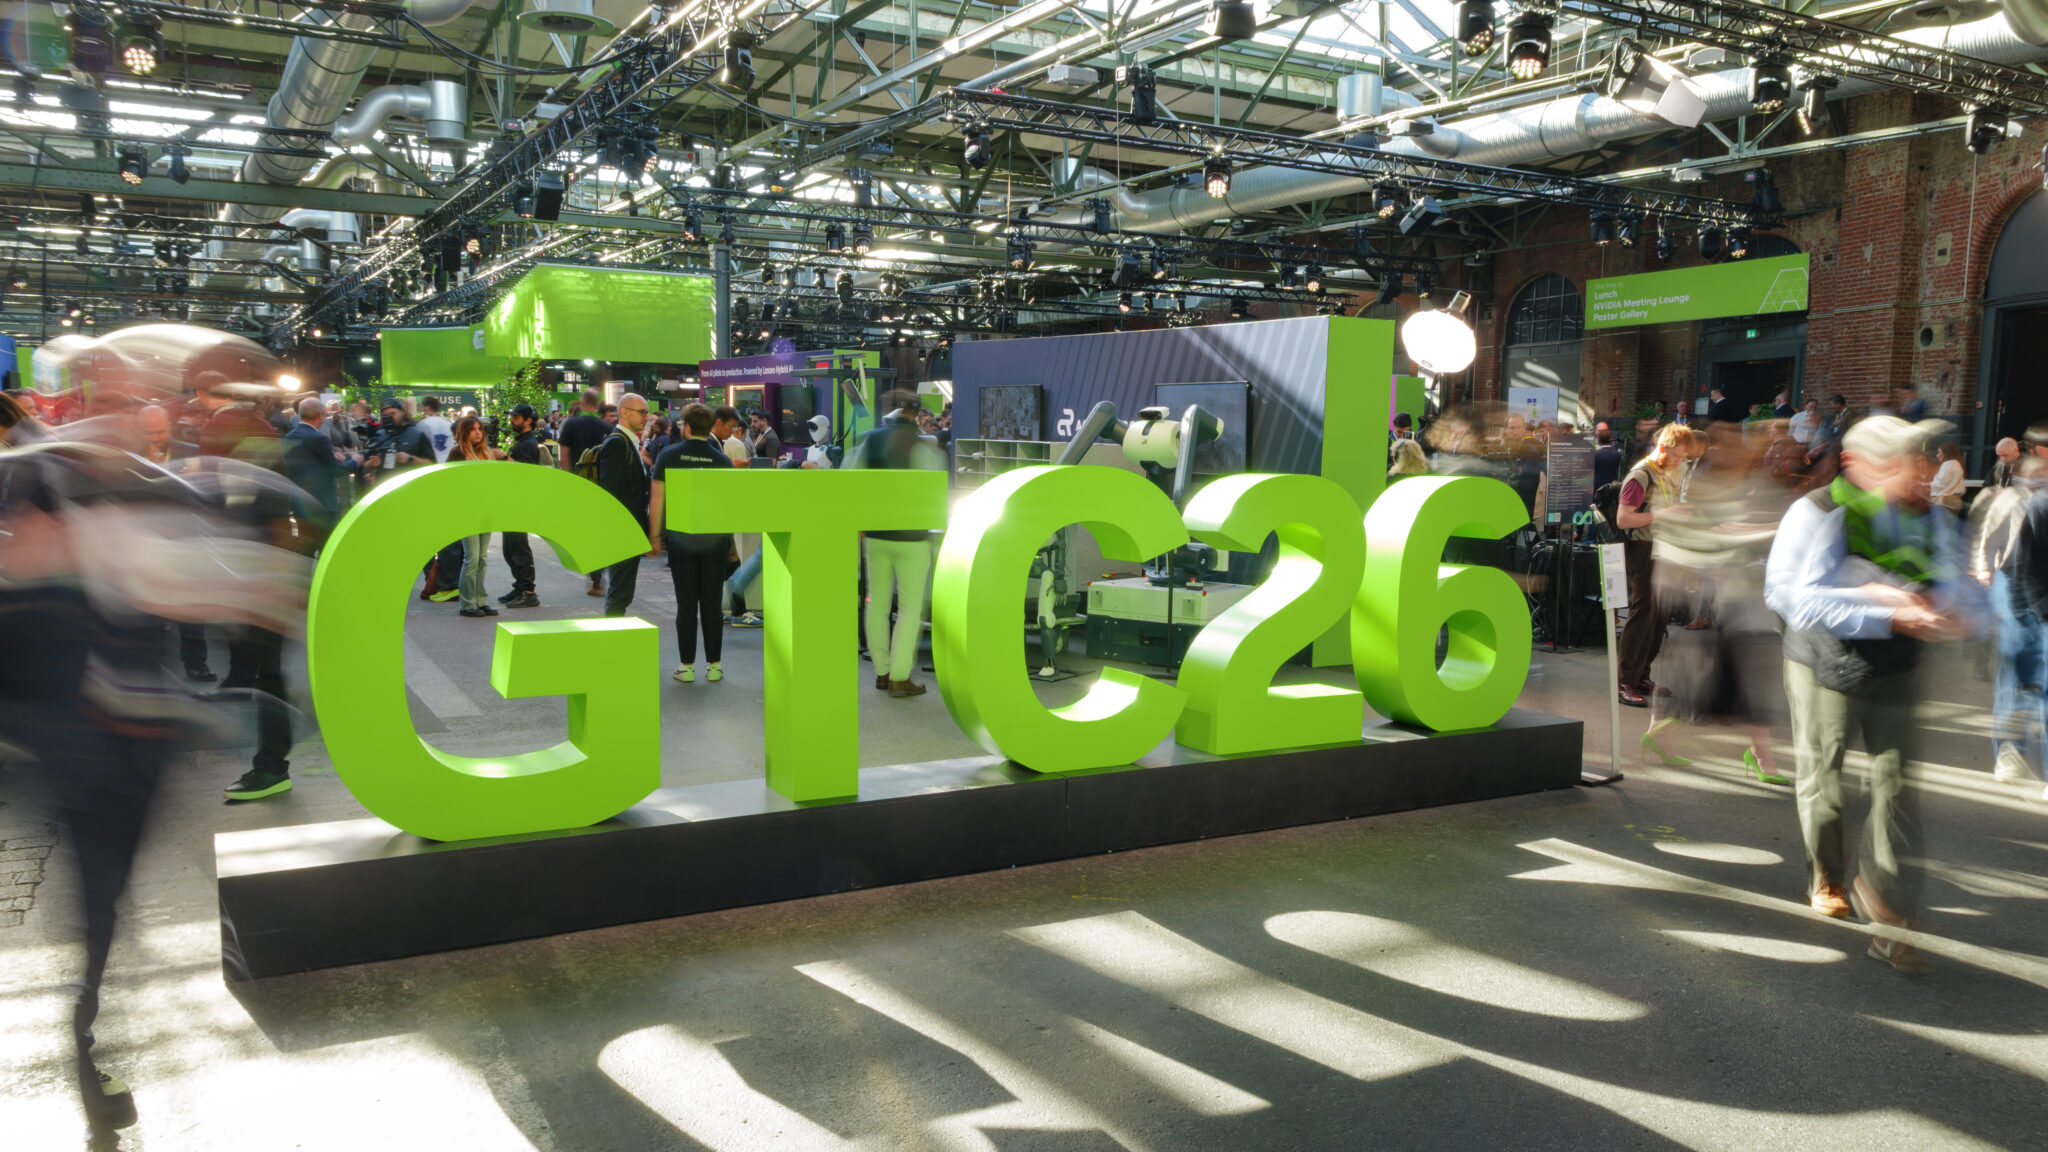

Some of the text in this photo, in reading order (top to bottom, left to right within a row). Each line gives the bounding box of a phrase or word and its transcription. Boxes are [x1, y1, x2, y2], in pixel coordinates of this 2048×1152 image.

[1594, 290, 1618, 300] Lunch
[1593, 294, 1690, 311] NVIDIA Meeting Lounge
[1593, 310, 1649, 321] Poster Gallery
[776, 365, 789, 375] Hybrid
[434, 396, 462, 404] USE
[308, 461, 1532, 842] GTC26
